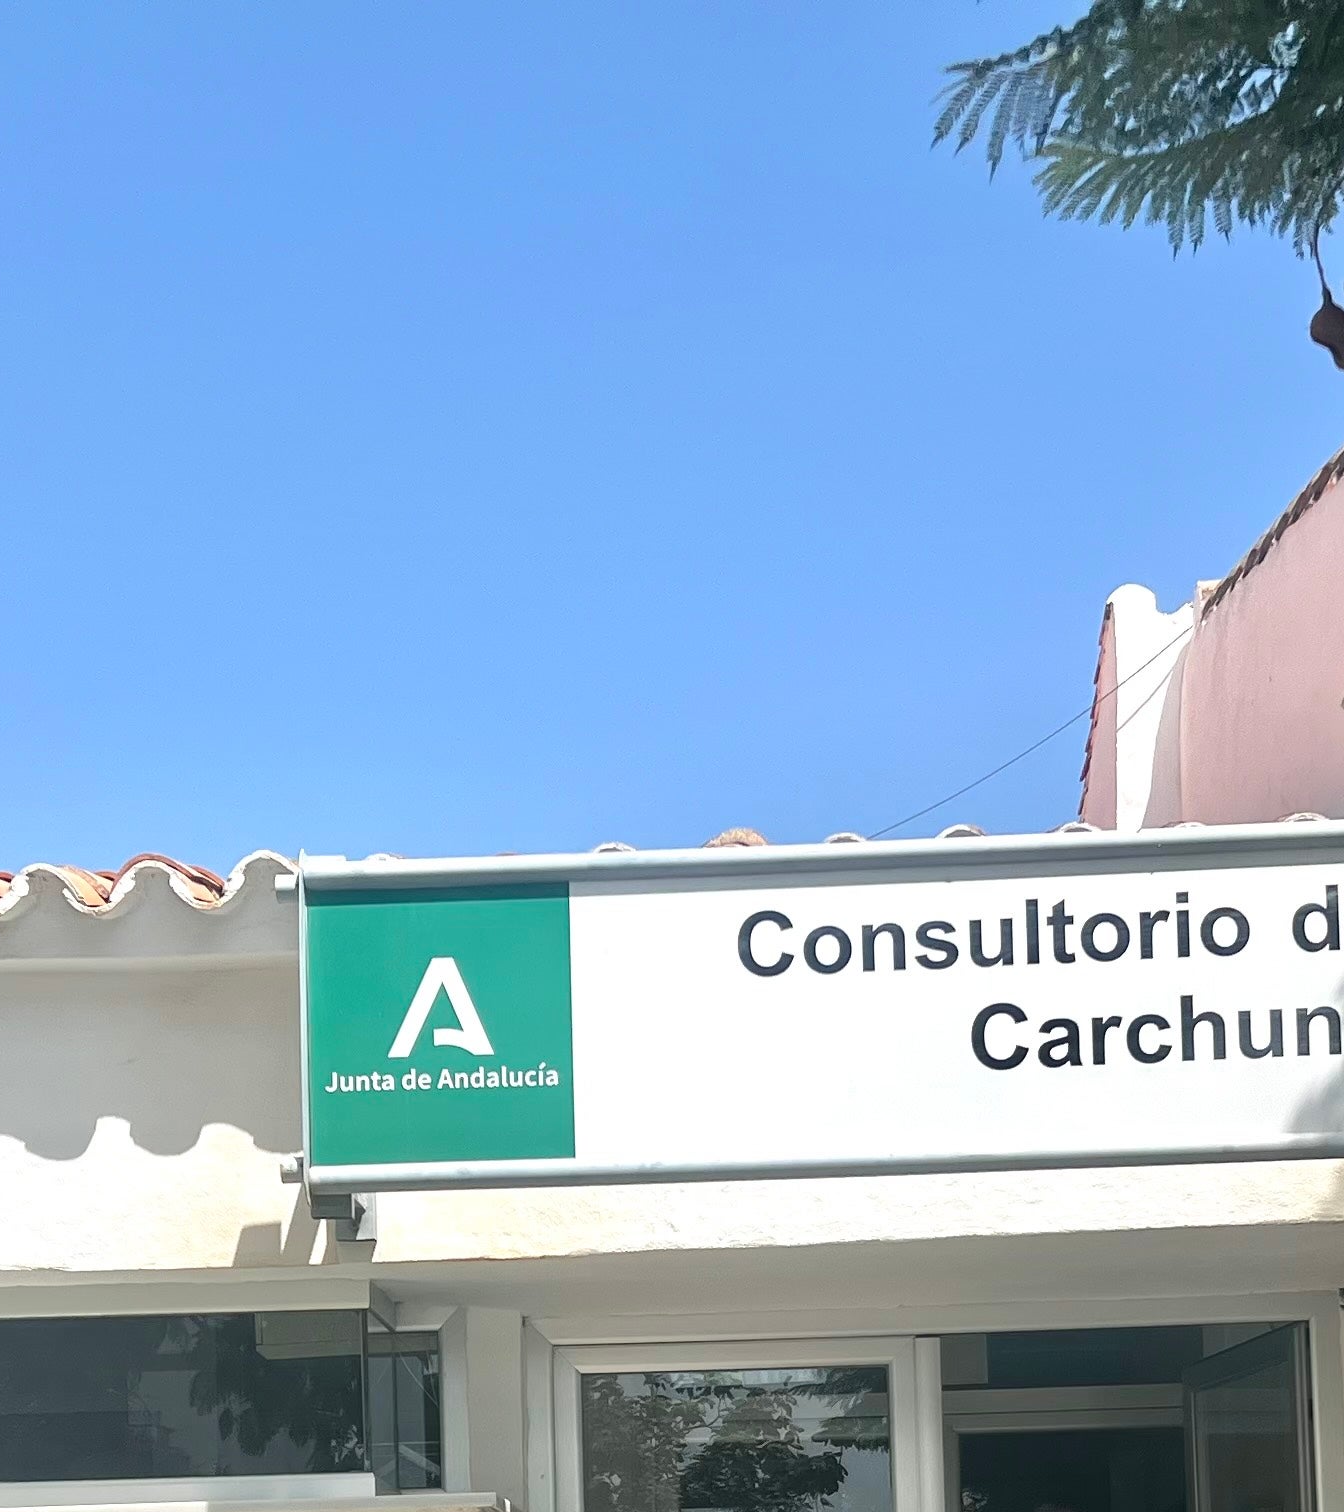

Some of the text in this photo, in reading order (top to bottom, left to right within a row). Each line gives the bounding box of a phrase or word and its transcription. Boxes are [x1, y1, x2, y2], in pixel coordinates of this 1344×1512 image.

[737, 891, 1251, 978] Consultorio
[324, 1061, 559, 1094] Junta de Andalucía
